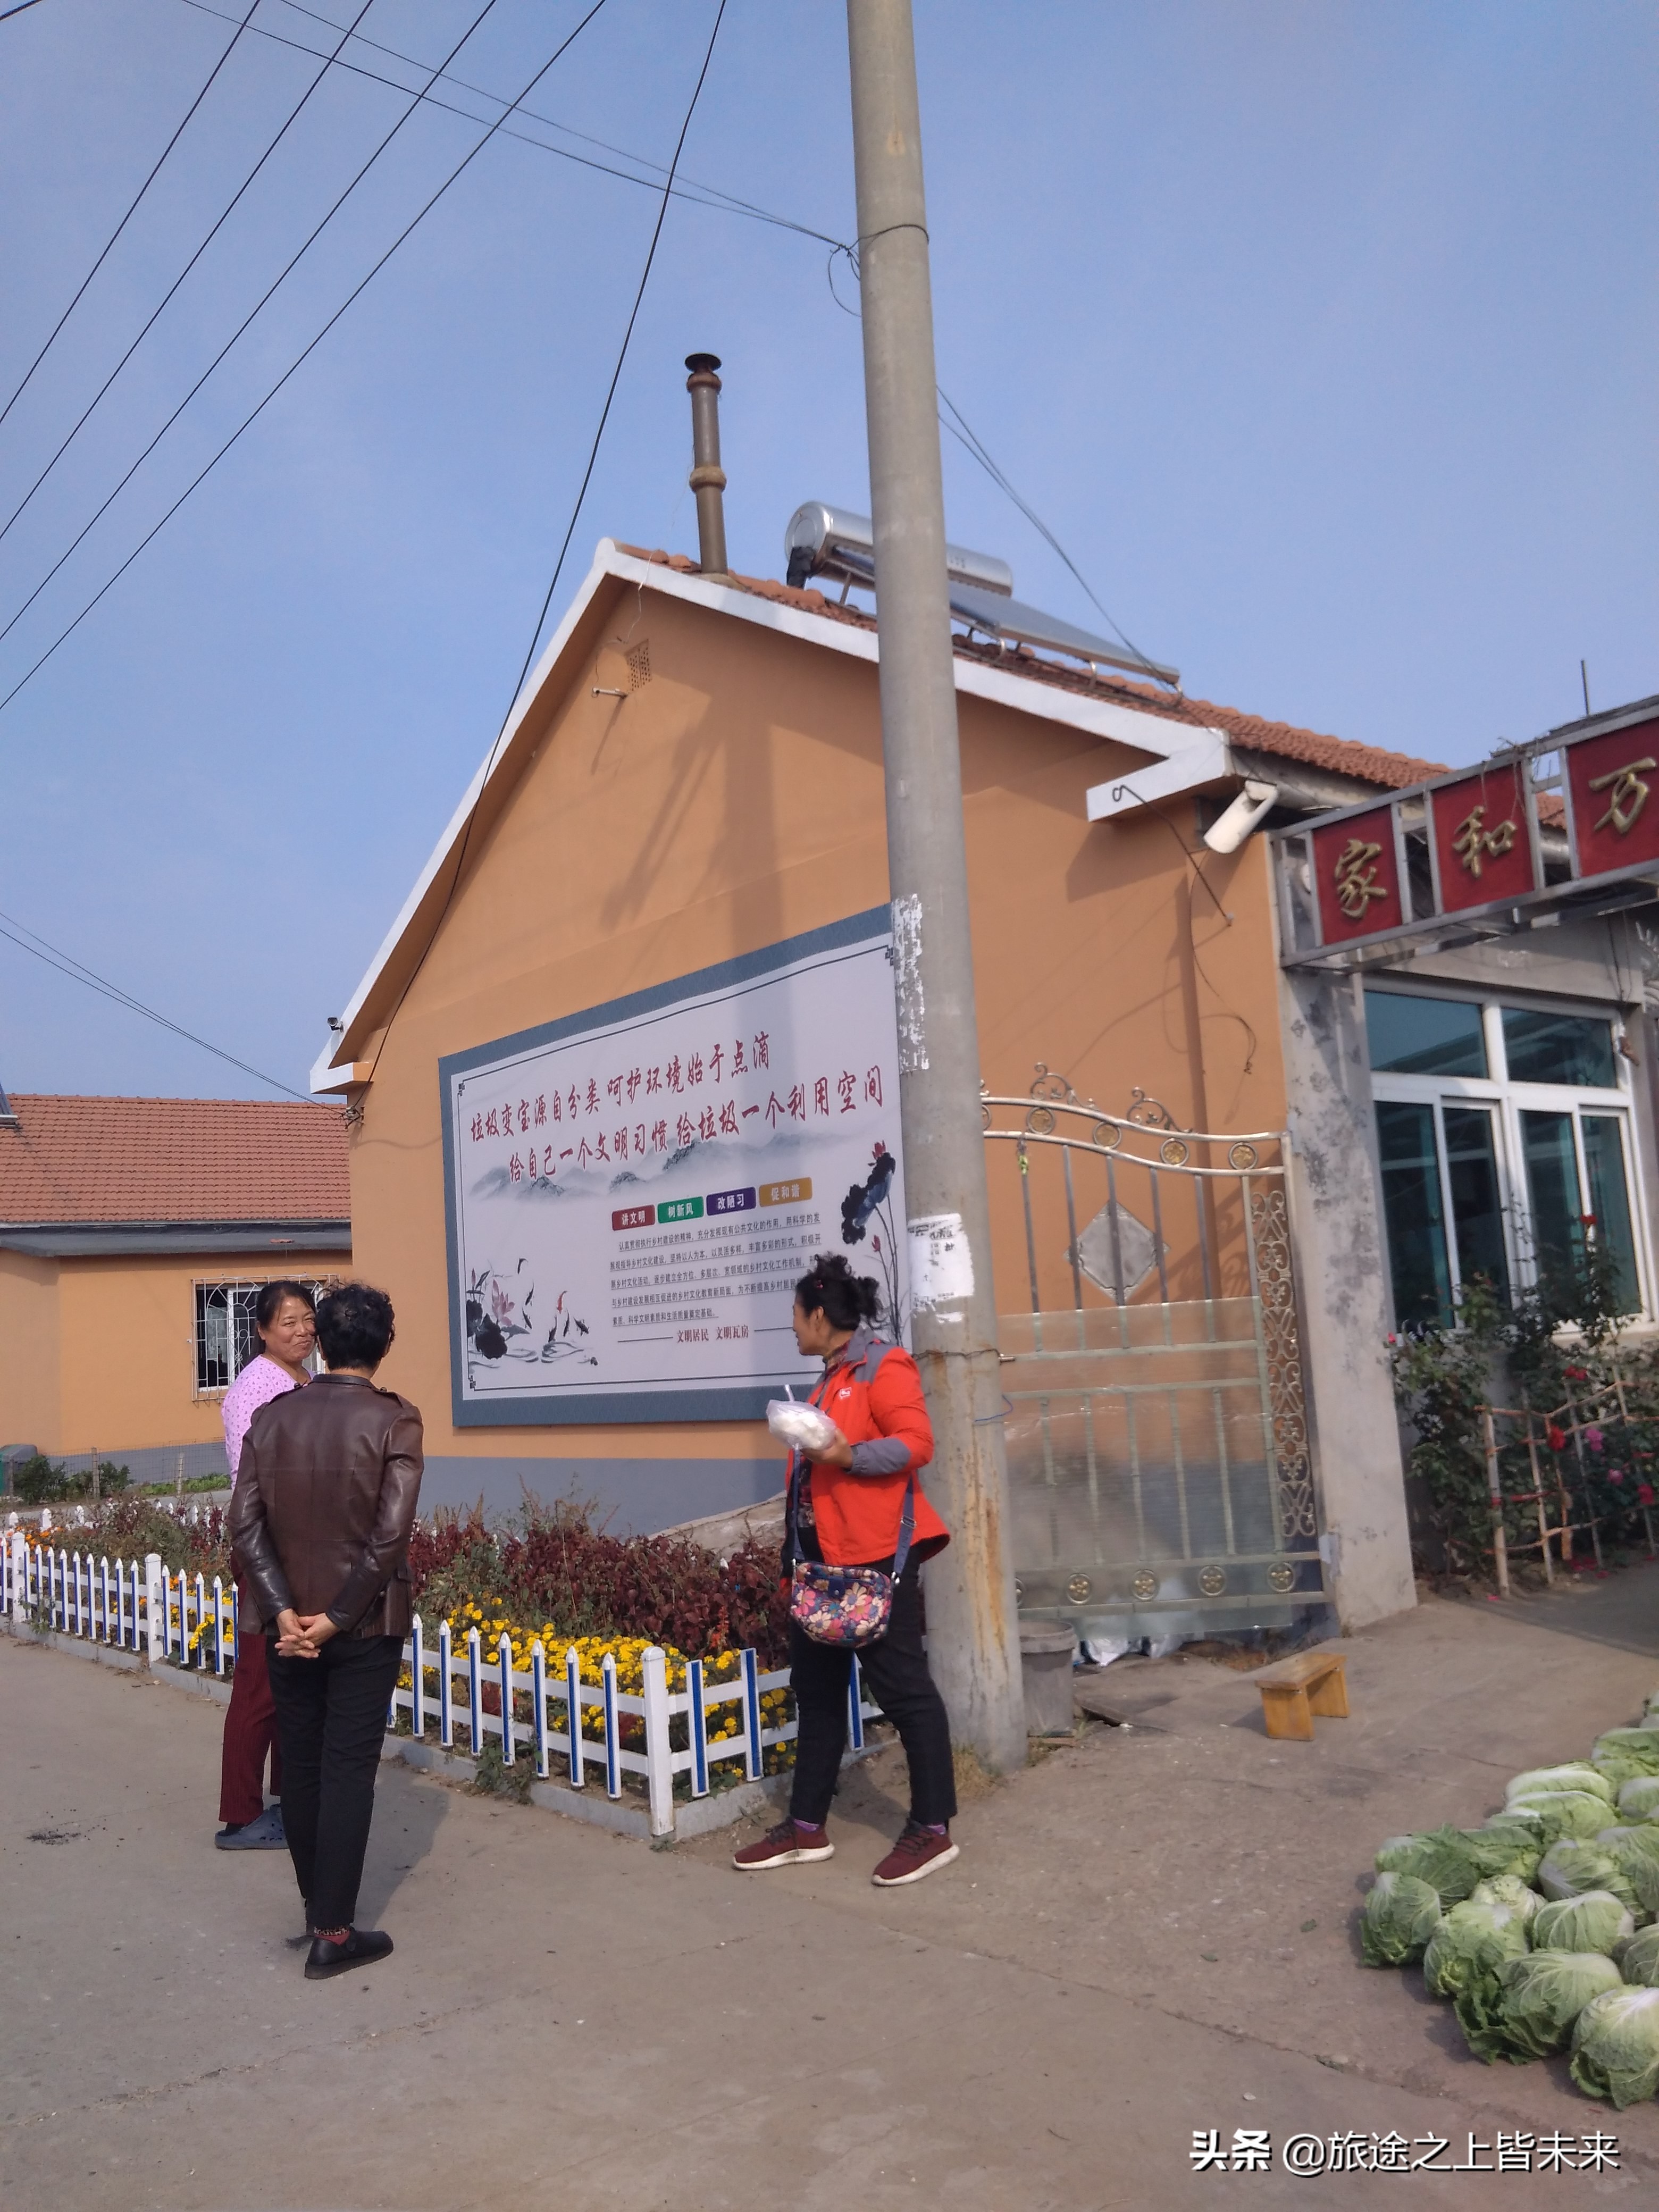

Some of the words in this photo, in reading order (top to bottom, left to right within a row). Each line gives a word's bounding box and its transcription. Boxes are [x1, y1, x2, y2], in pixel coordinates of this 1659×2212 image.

[471, 1078, 600, 1143] 垃圾变宝源自分类
[607, 1030, 770, 1106] 呵护环境始于点滴
[509, 1119, 668, 1183] 给自己一个文明习惯
[677, 1065, 883, 1146] 给垃圾一个利用空间
[622, 1210, 646, 1226] 讲文明
[668, 1203, 693, 1218] 树新风
[717, 1193, 744, 1210] 改陋习
[771, 1184, 800, 1201] 促和谐
[677, 1329, 709, 1343] 文明居民
[716, 1325, 749, 1340] 文明瓦房
